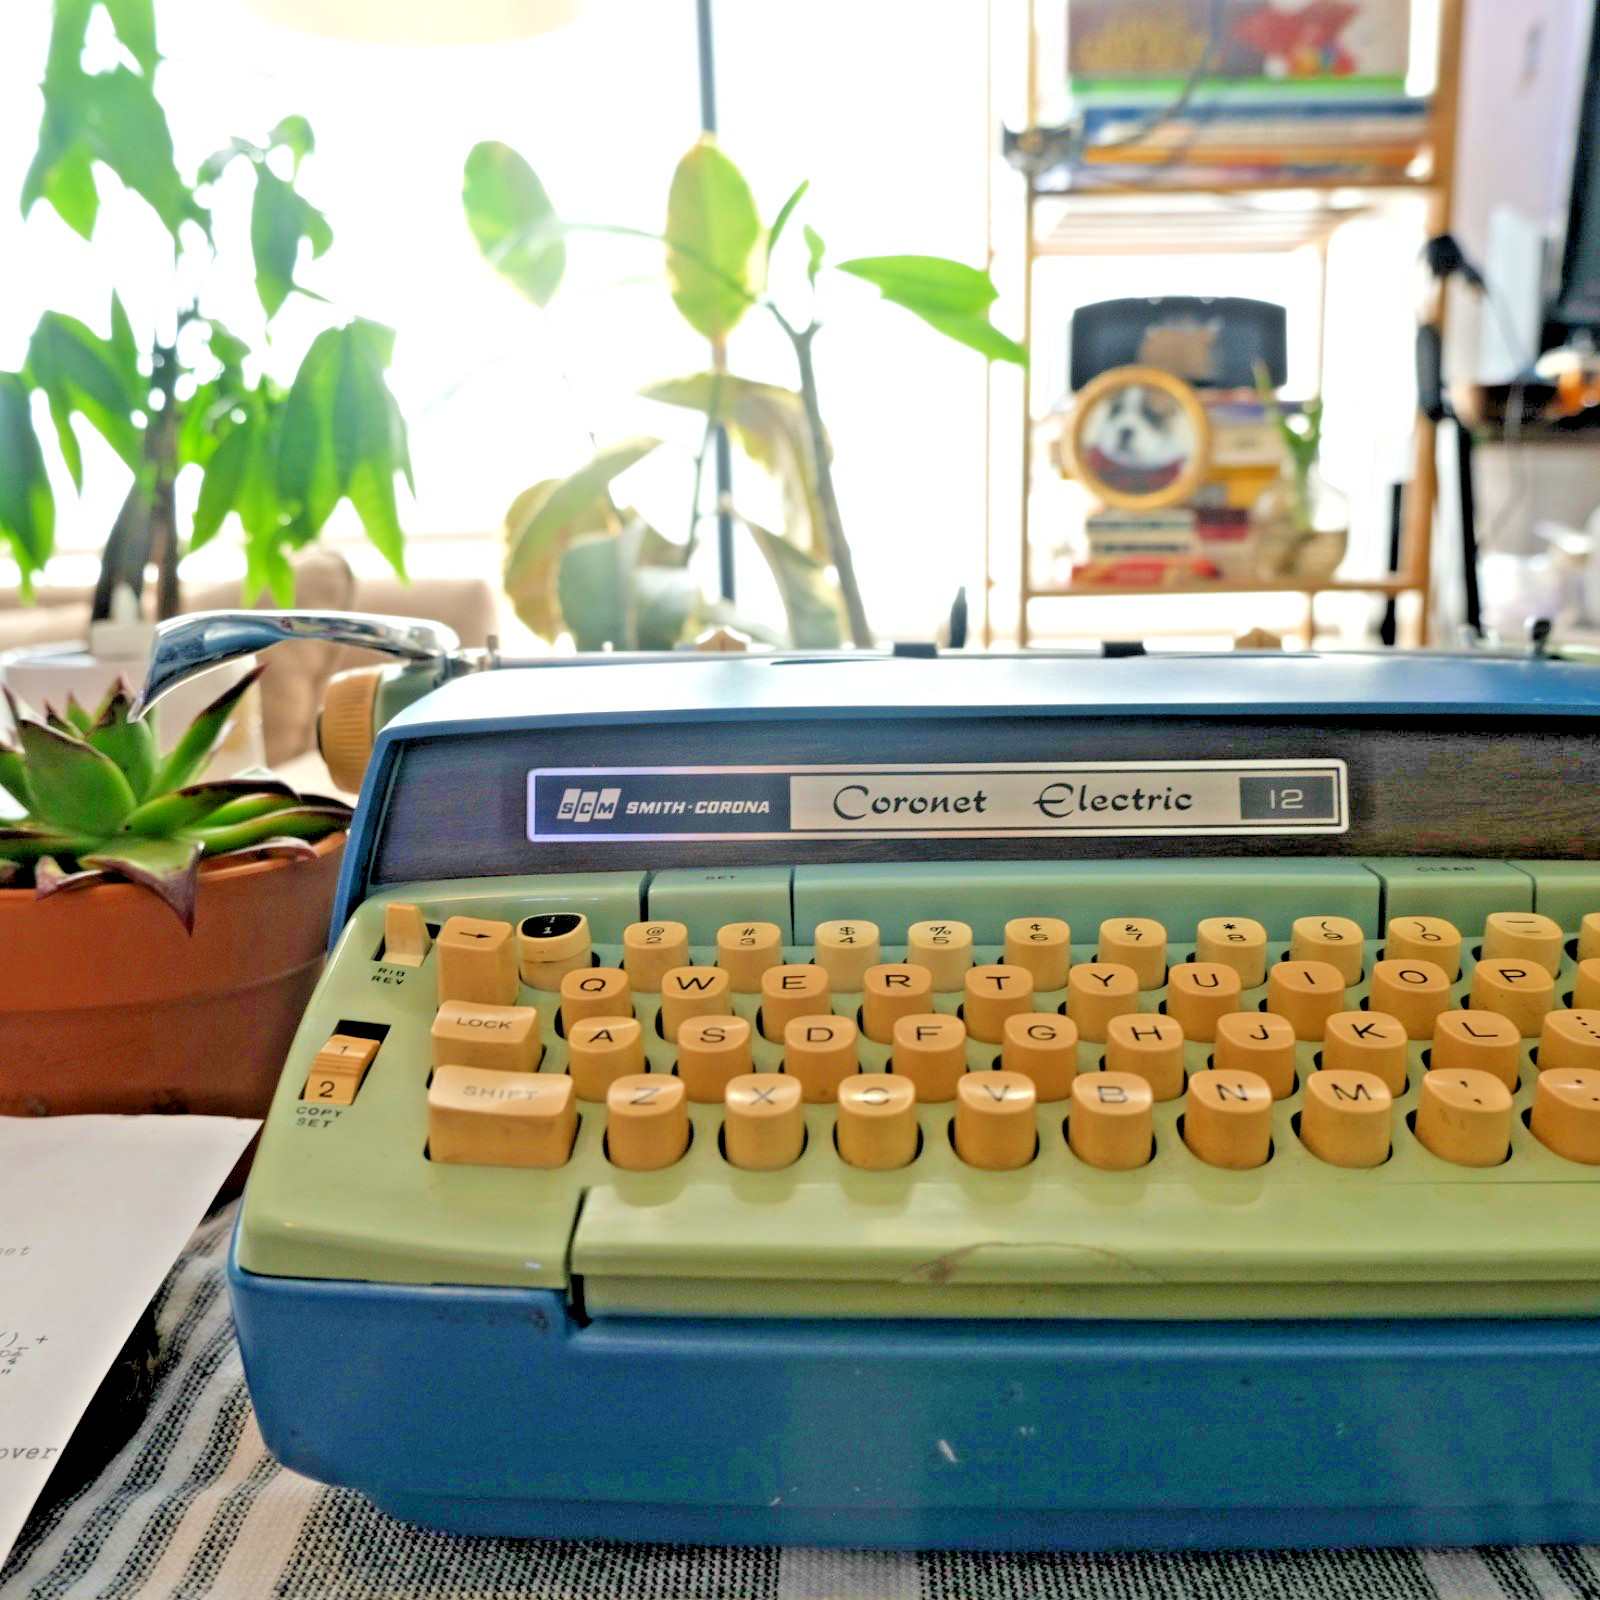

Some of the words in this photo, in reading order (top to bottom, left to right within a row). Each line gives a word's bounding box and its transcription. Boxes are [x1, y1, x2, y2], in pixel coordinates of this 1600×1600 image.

[833, 784, 987, 820] Coronet
[1032, 782, 1193, 818] Electric
[1270, 788, 1304, 809] 12
[646, 926, 665, 936] @
[741, 927, 757, 936] #
[839, 926, 856, 936] $
[929, 926, 952, 937] %
[1320, 921, 1333, 932] (
[1413, 921, 1427, 933] )
[645, 936, 662, 945] 2
[740, 937, 756, 946] 3
[839, 936, 857, 945] 4
[932, 936, 950, 945] 5
[1029, 933, 1049, 942] 6
[1126, 933, 1143, 941] 7
[1226, 934, 1247, 942] 8
[1323, 932, 1344, 941] 9
[377, 967, 406, 978] RIB
[1304, 971, 1316, 985] I
[1399, 969, 1428, 985] O
[1498, 969, 1527, 983] P
[371, 975, 405, 985] REV
[580, 978, 607, 992] Q
[676, 976, 715, 991] W
[782, 975, 807, 990] E
[885, 974, 911, 988] R
[985, 976, 1010, 991] T
[1090, 973, 1115, 987] Y
[1192, 973, 1219, 988] U
[456, 1017, 514, 1030] LOCK
[1462, 1022, 1499, 1038] L
[588, 1029, 615, 1044] A
[700, 1027, 726, 1044] S
[806, 1027, 834, 1043] D
[915, 1026, 943, 1041] F
[1027, 1025, 1057, 1041] G
[1130, 1025, 1163, 1042] H
[1249, 1024, 1270, 1041] J
[1351, 1023, 1387, 1039] K
[339, 1045, 349, 1054] 1
[318, 1080, 336, 1098] 2
[462, 1084, 540, 1101] SHIFT
[629, 1086, 661, 1106] Z
[750, 1086, 776, 1106] X
[983, 1084, 1011, 1103] V
[1097, 1085, 1128, 1104] B
[1216, 1083, 1249, 1101] N
[1331, 1083, 1372, 1102] M
[296, 1106, 344, 1119] COPY
[296, 1117, 333, 1129] SET
